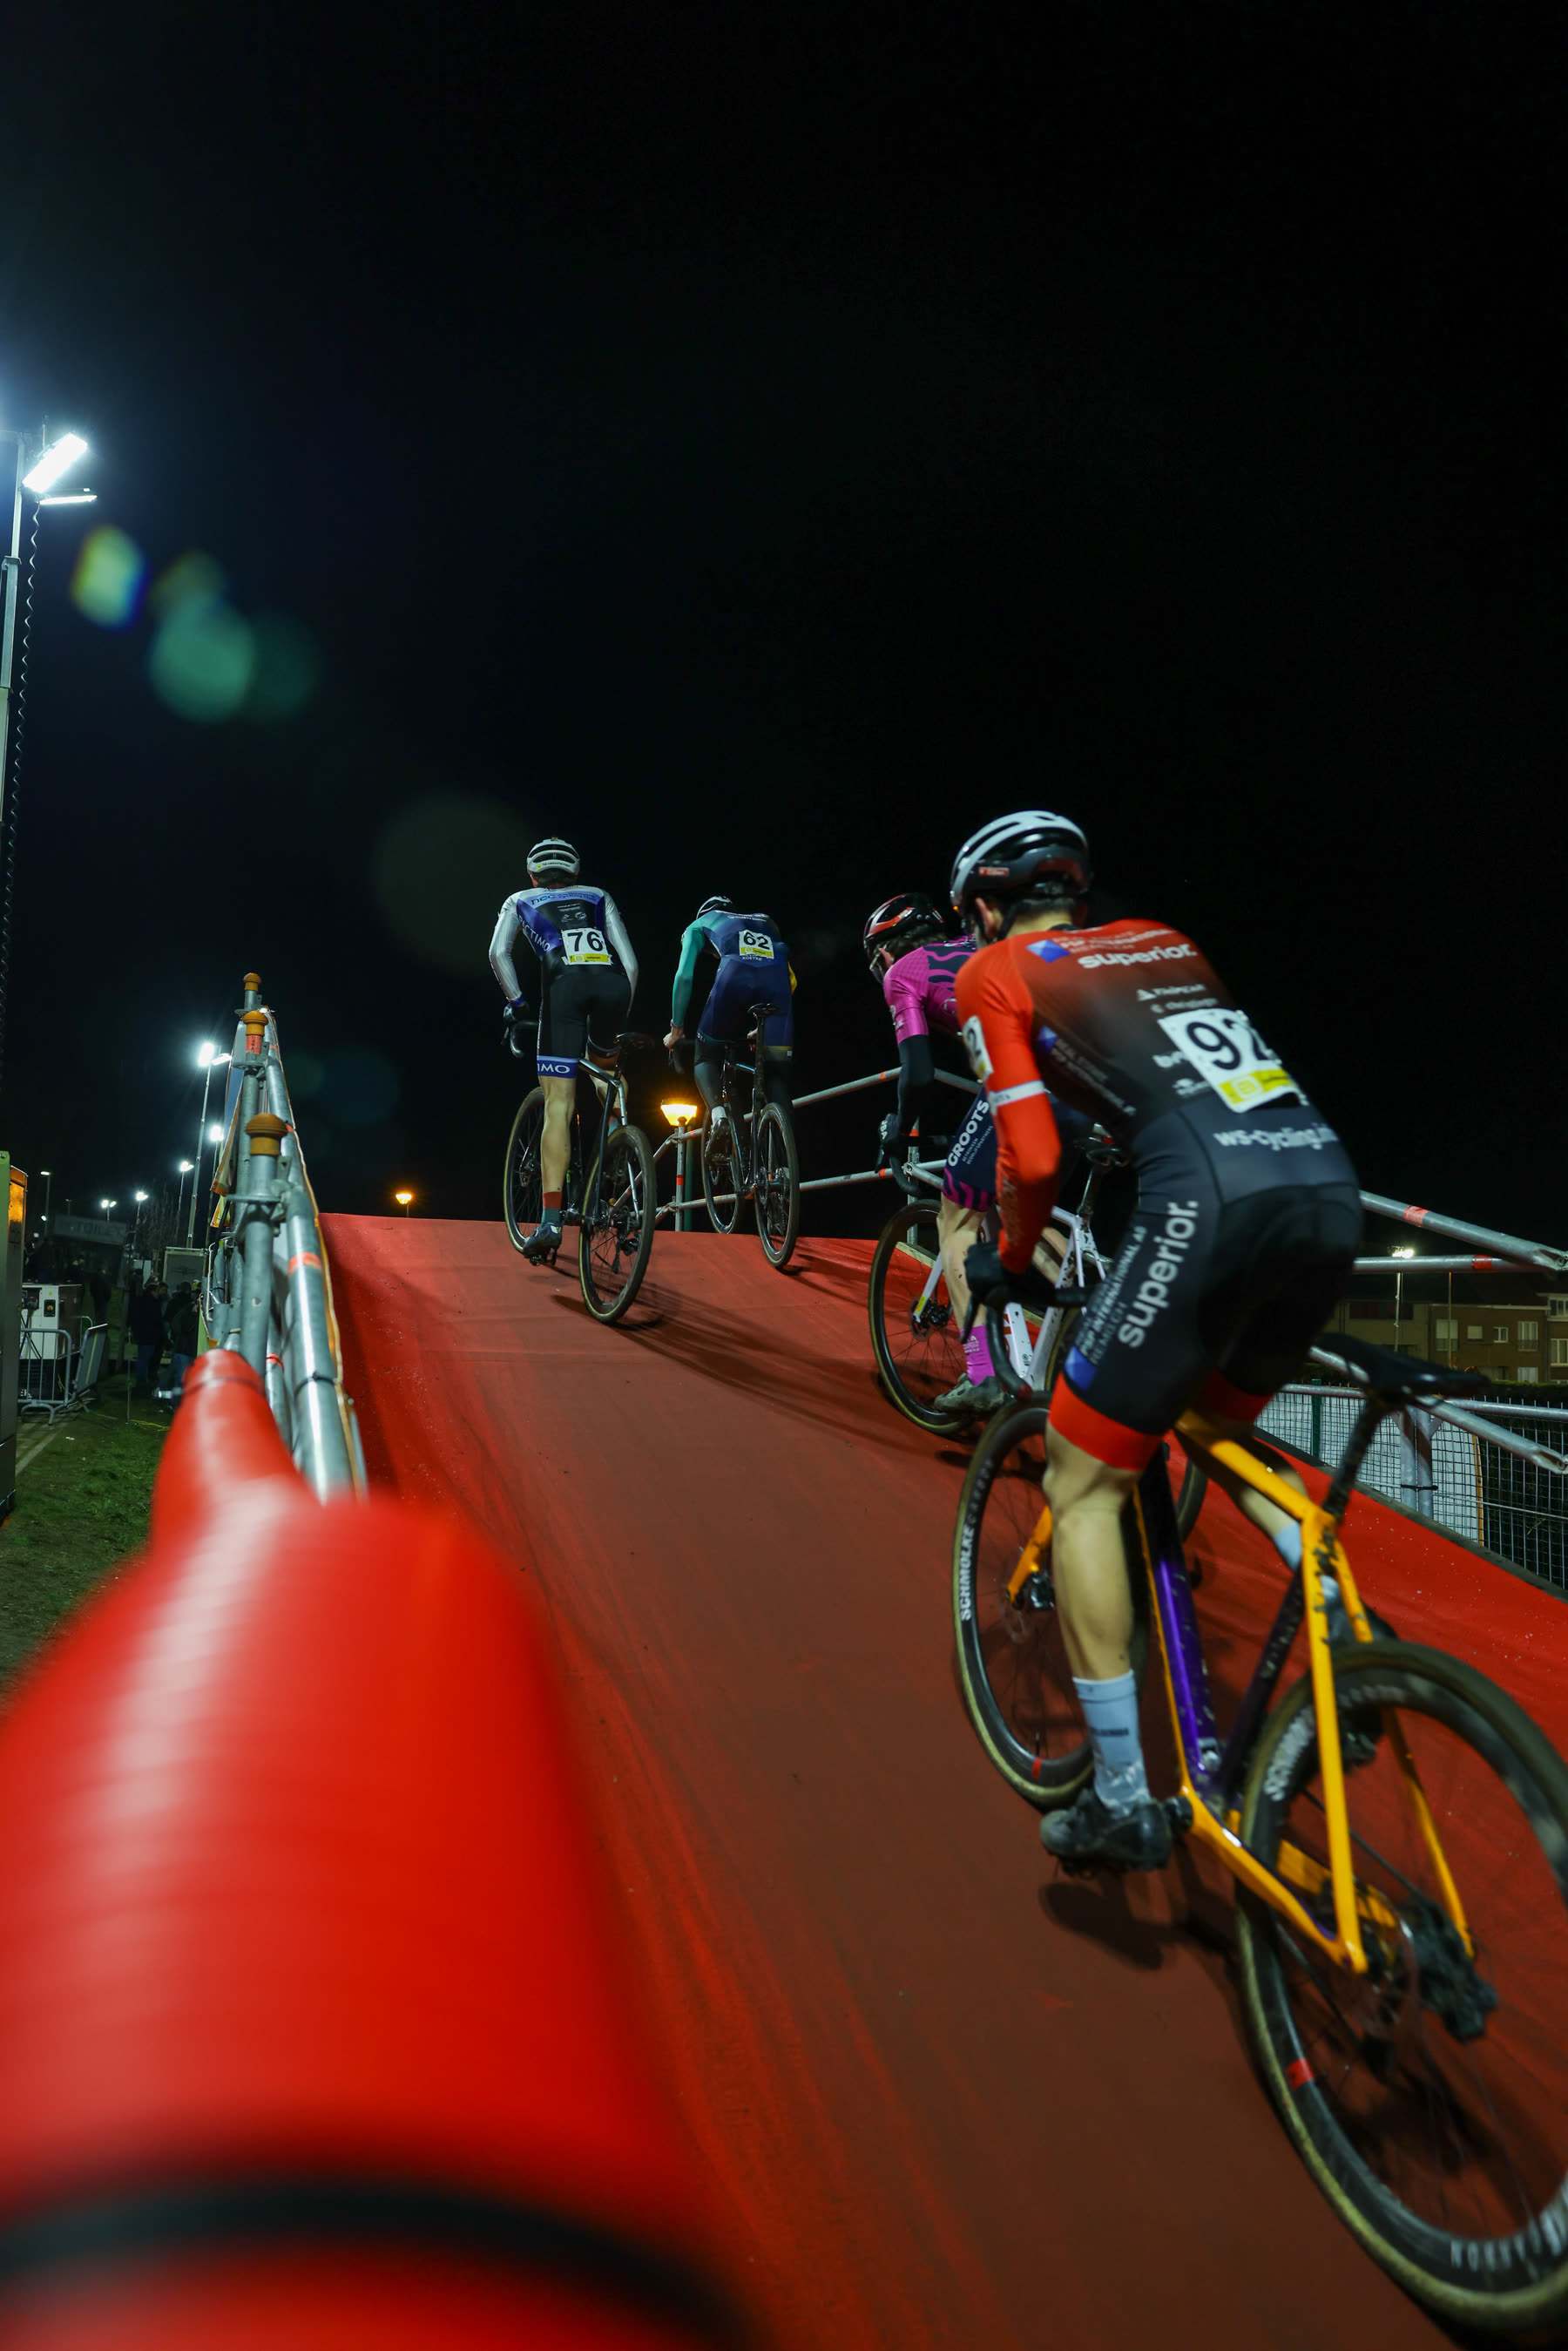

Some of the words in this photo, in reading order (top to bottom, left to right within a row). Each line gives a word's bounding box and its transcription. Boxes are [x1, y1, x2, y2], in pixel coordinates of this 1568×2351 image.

[567, 931, 604, 952] 76
[743, 932, 770, 951] 62
[537, 1063, 571, 1074] IMO
[947, 1100, 990, 1167] GROOTS
[1118, 1200, 1200, 1348] superior.
[958, 1527, 976, 1622] SCHMOLKE
